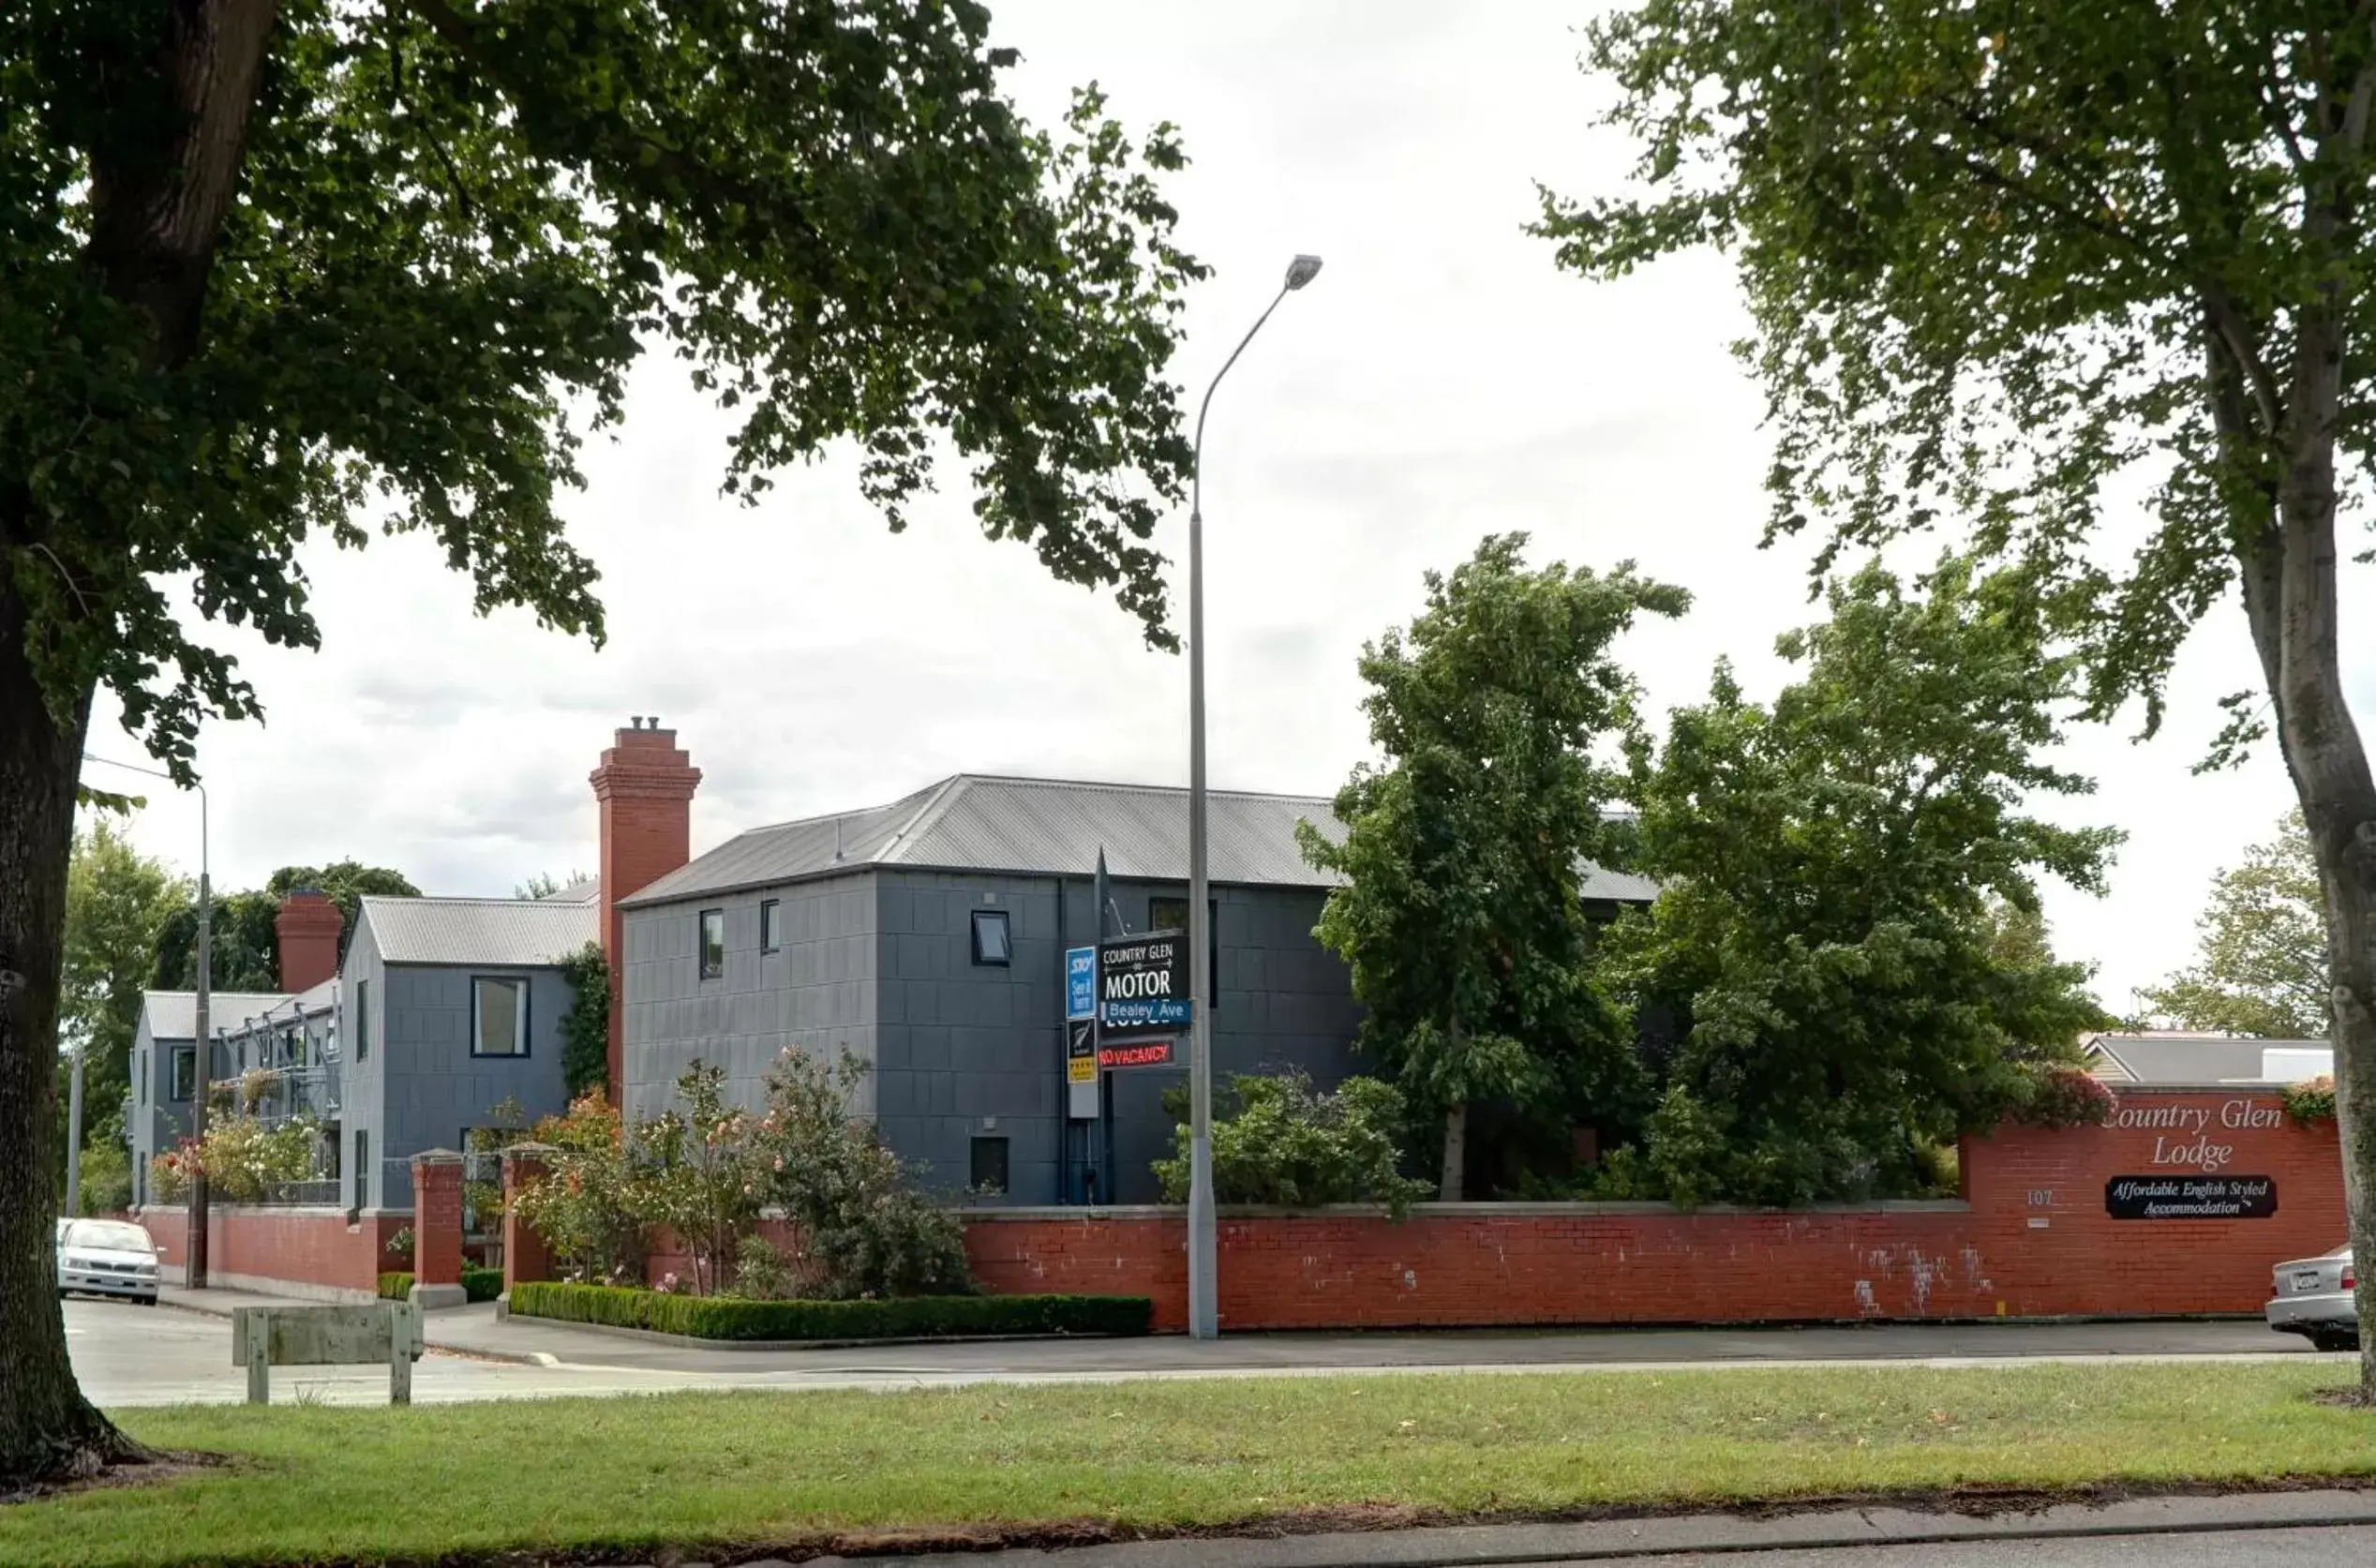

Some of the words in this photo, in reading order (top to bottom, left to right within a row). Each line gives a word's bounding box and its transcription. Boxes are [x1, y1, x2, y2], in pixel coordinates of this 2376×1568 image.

[1103, 947, 1146, 963] COUNTRY
[1149, 944, 1173, 960] GLEN
[1106, 970, 1171, 1000] MOTOR
[1109, 1003, 1154, 1020] Bealey
[1158, 1004, 1185, 1017] Ave
[1098, 1049, 1113, 1065] NO
[1114, 1044, 1167, 1065] VACANCY
[2101, 1100, 2211, 1136] Country
[2220, 1099, 2282, 1129] Glen
[2152, 1135, 2234, 1172] Lodge
[2027, 1189, 2053, 1205] 107
[2114, 1181, 2179, 1200] Affordable
[2183, 1181, 2226, 1200] English
[2230, 1181, 2268, 1199] Styled
[2144, 1200, 2241, 1216] Accommodation
